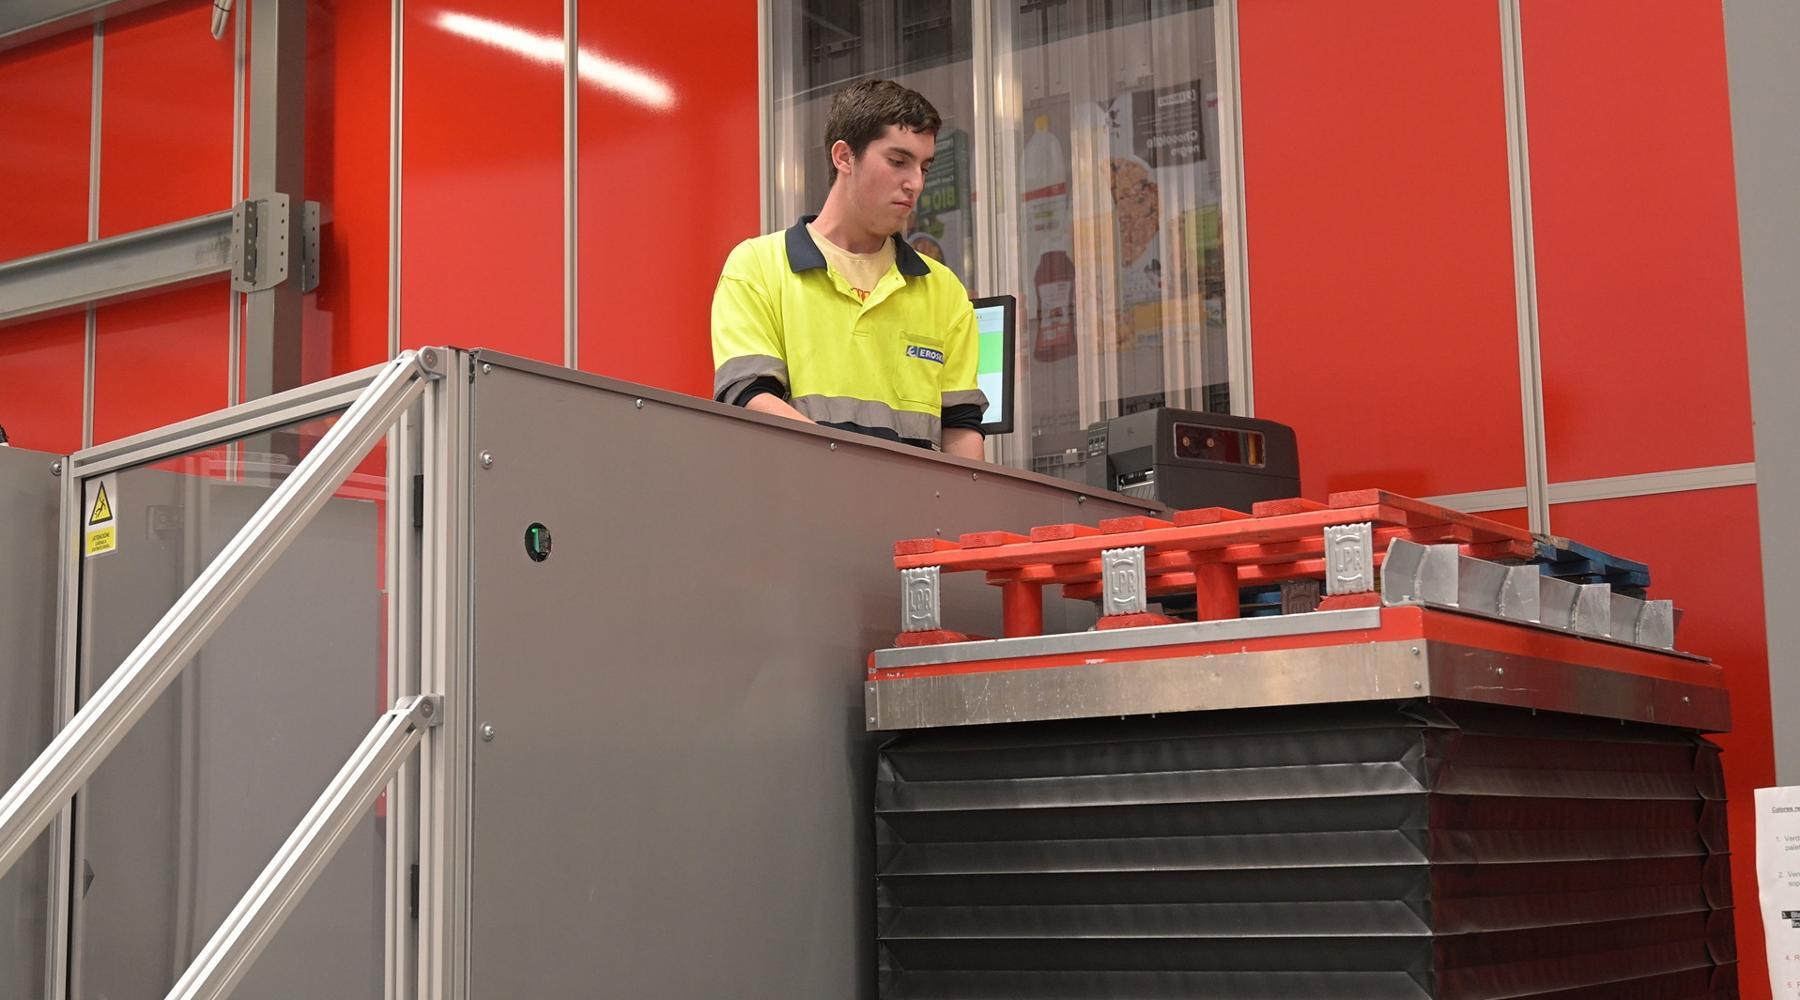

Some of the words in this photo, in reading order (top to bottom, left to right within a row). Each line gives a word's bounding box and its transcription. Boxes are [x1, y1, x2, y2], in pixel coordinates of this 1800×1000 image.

[1335, 545, 1362, 573] LPR
[1111, 570, 1136, 593] LPR
[910, 588, 931, 610] LPR
